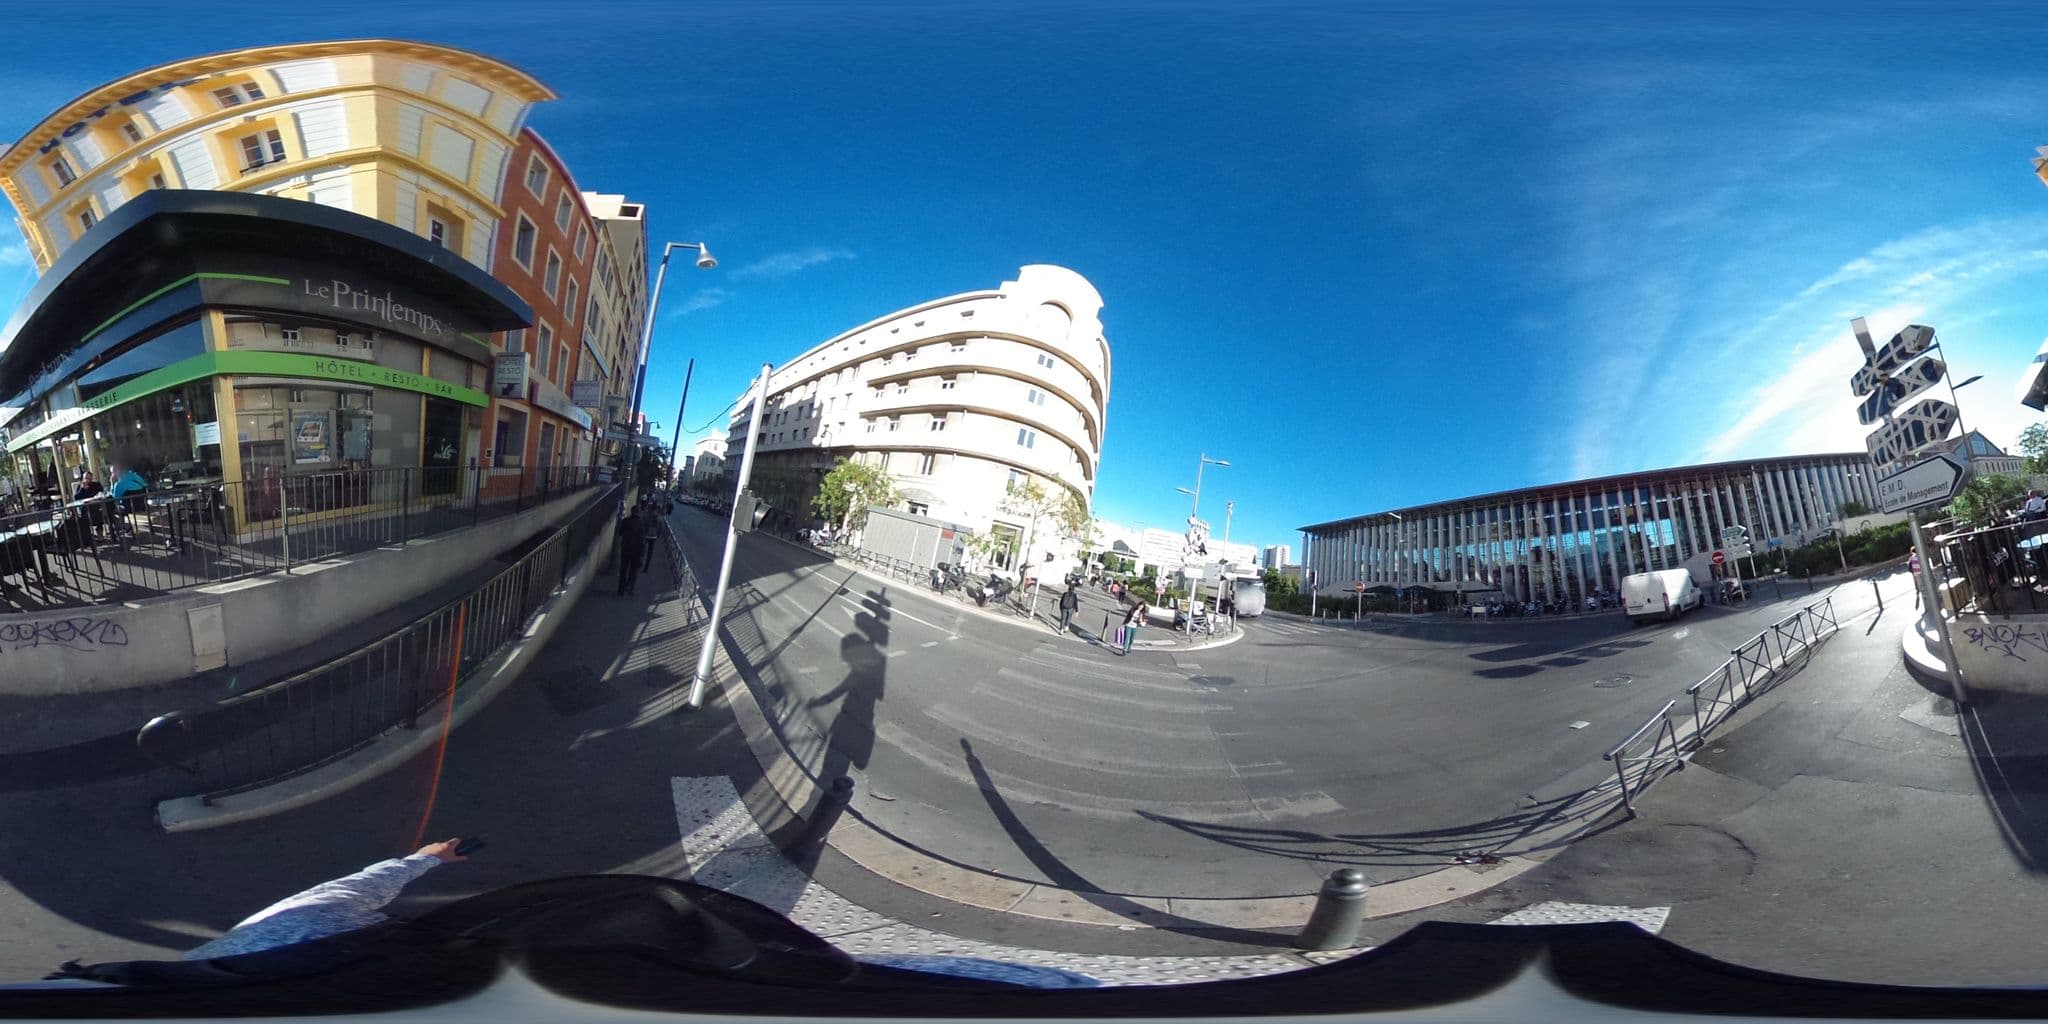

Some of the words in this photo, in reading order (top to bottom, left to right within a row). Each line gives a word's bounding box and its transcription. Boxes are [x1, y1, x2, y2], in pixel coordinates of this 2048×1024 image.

[304, 278, 329, 298] Le
[331, 279, 442, 336] Printemps
[315, 360, 362, 378] HÔTEL
[384, 372, 420, 388] RESTO
[435, 383, 452, 395] BAR
[1907, 480, 1949, 500] Management
